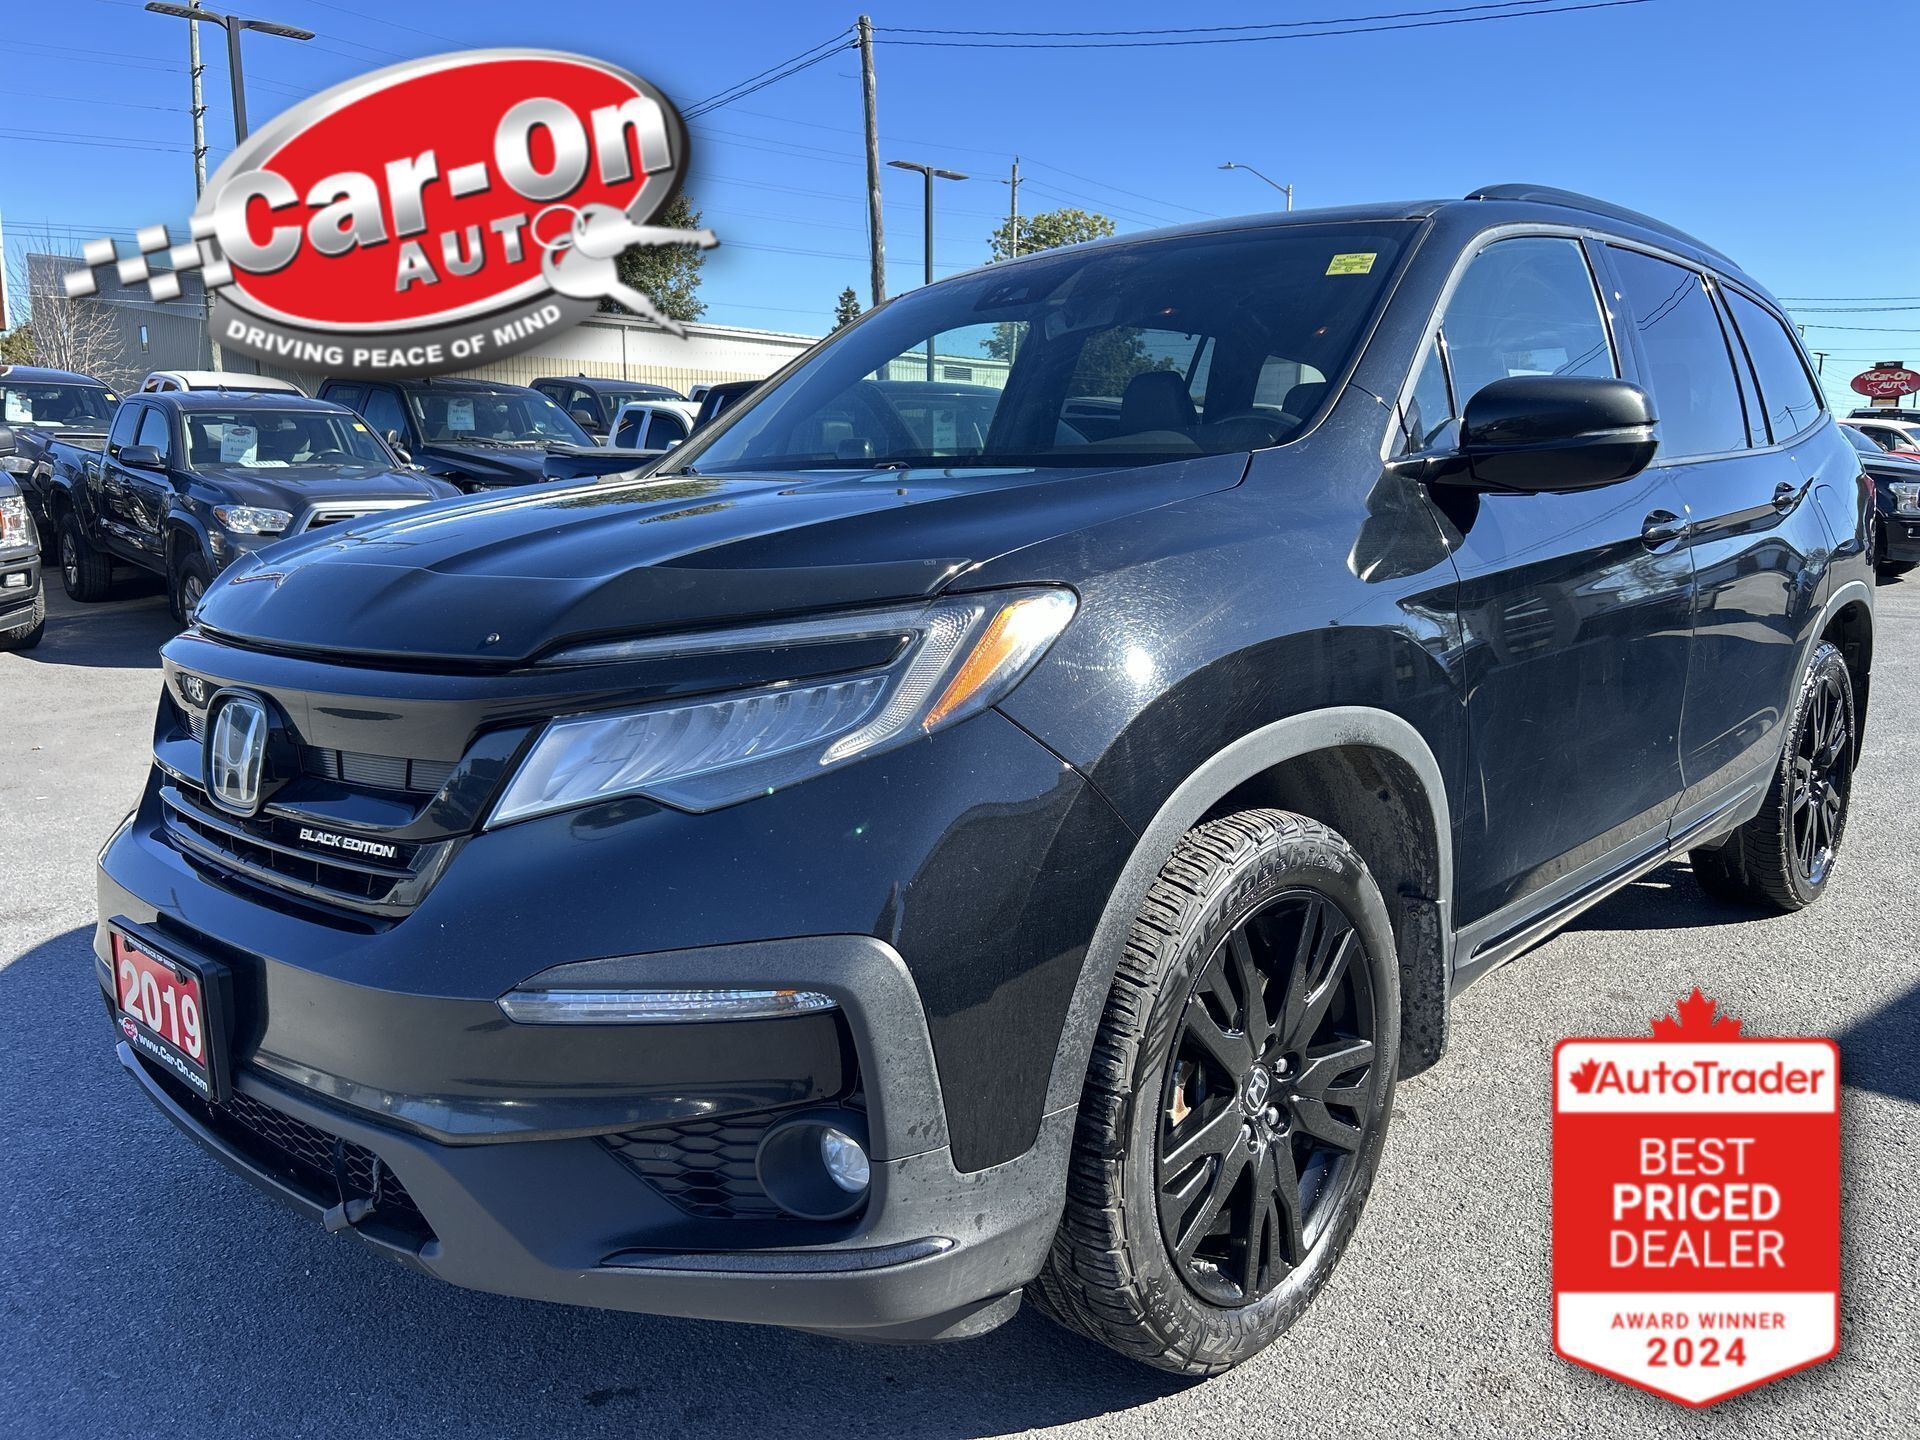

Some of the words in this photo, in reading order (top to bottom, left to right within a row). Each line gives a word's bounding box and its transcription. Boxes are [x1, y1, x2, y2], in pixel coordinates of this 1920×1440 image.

[1871, 371, 1912, 381] Car-On
[300, 827, 342, 847] BLACK
[342, 837, 396, 858] EDITION
[120, 959, 201, 1059] 2019
[138, 1033, 208, 1093] www.Car-On.com
